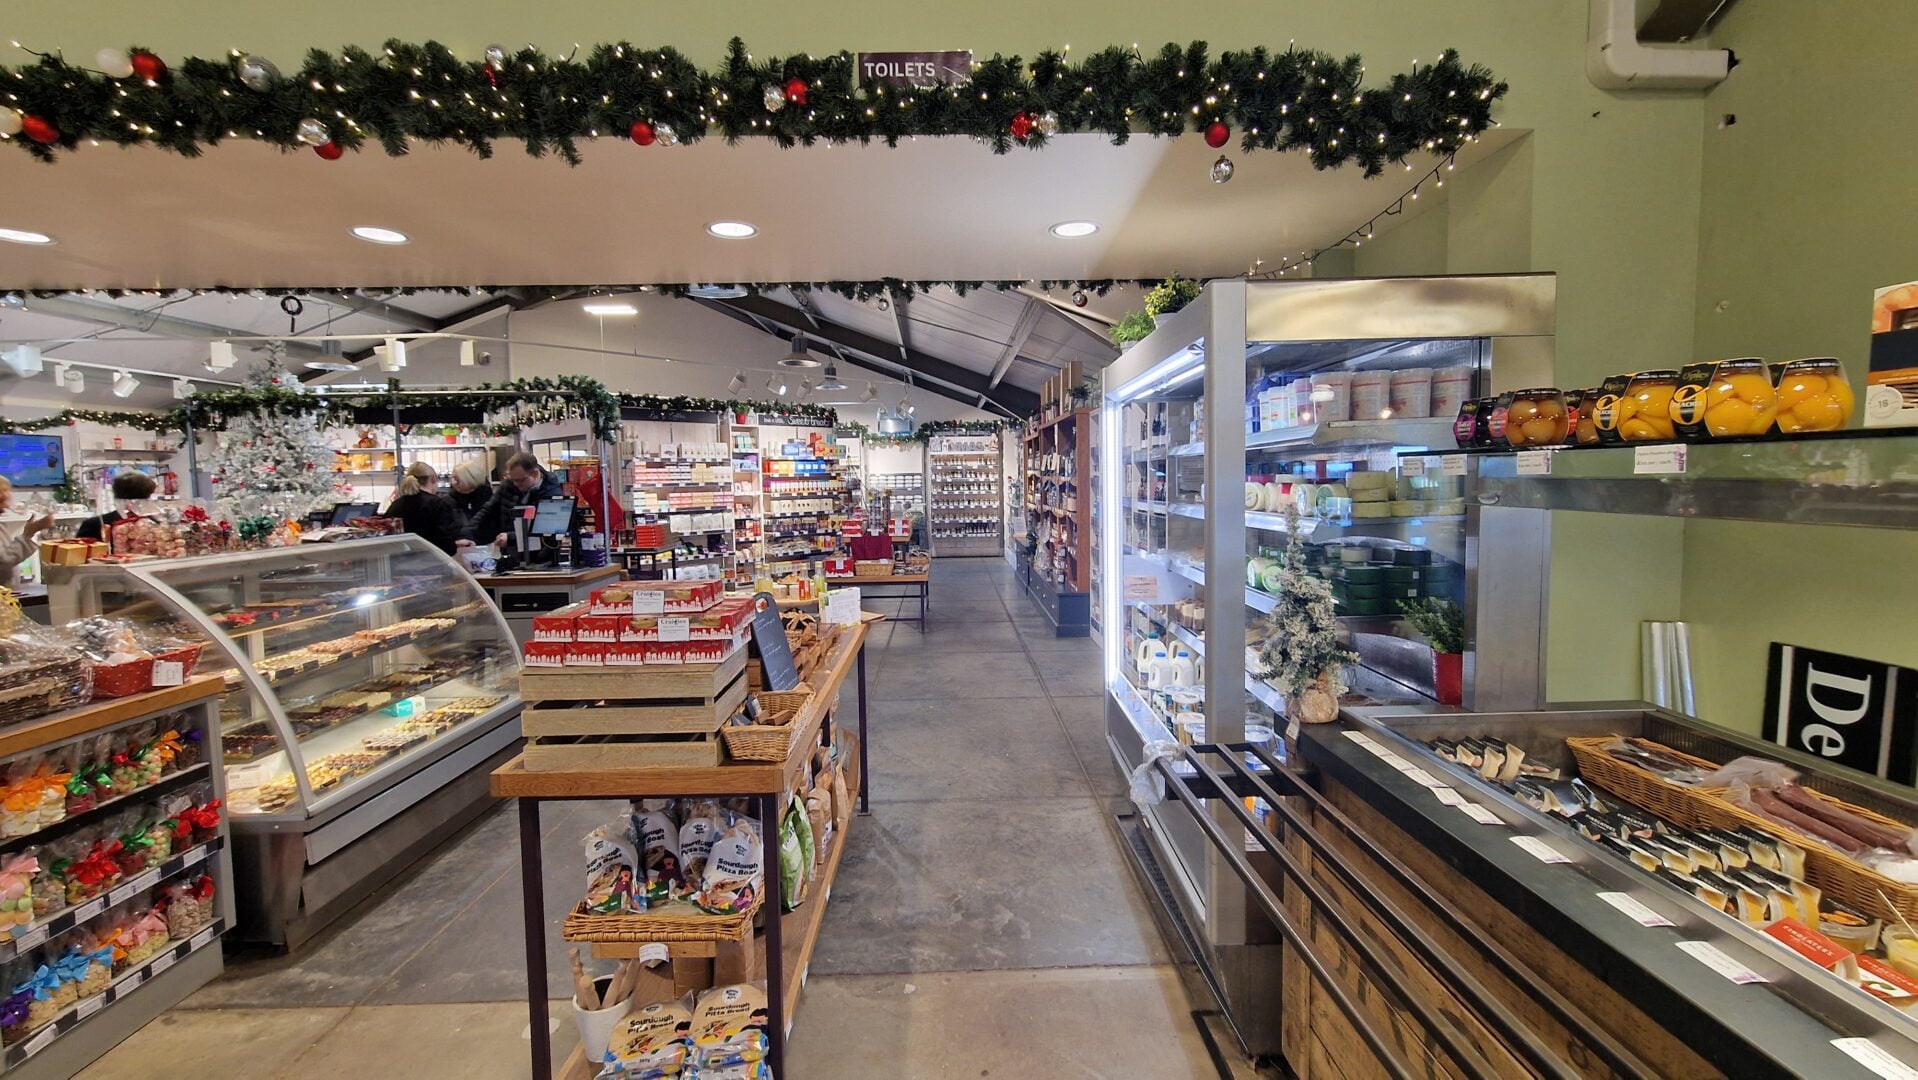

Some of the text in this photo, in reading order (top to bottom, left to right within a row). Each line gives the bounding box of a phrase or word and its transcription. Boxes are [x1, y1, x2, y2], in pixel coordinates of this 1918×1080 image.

[864, 62, 936, 77] TOILETS
[1878, 400, 1889, 408] 16
[718, 858, 759, 869] Sourdough
[716, 864, 737, 875] Pizza
[708, 1002, 751, 1012] Sourdough
[705, 1010, 726, 1018] Pitta
[629, 1014, 674, 1027] Sourdough
[627, 1027, 649, 1035] Pita
